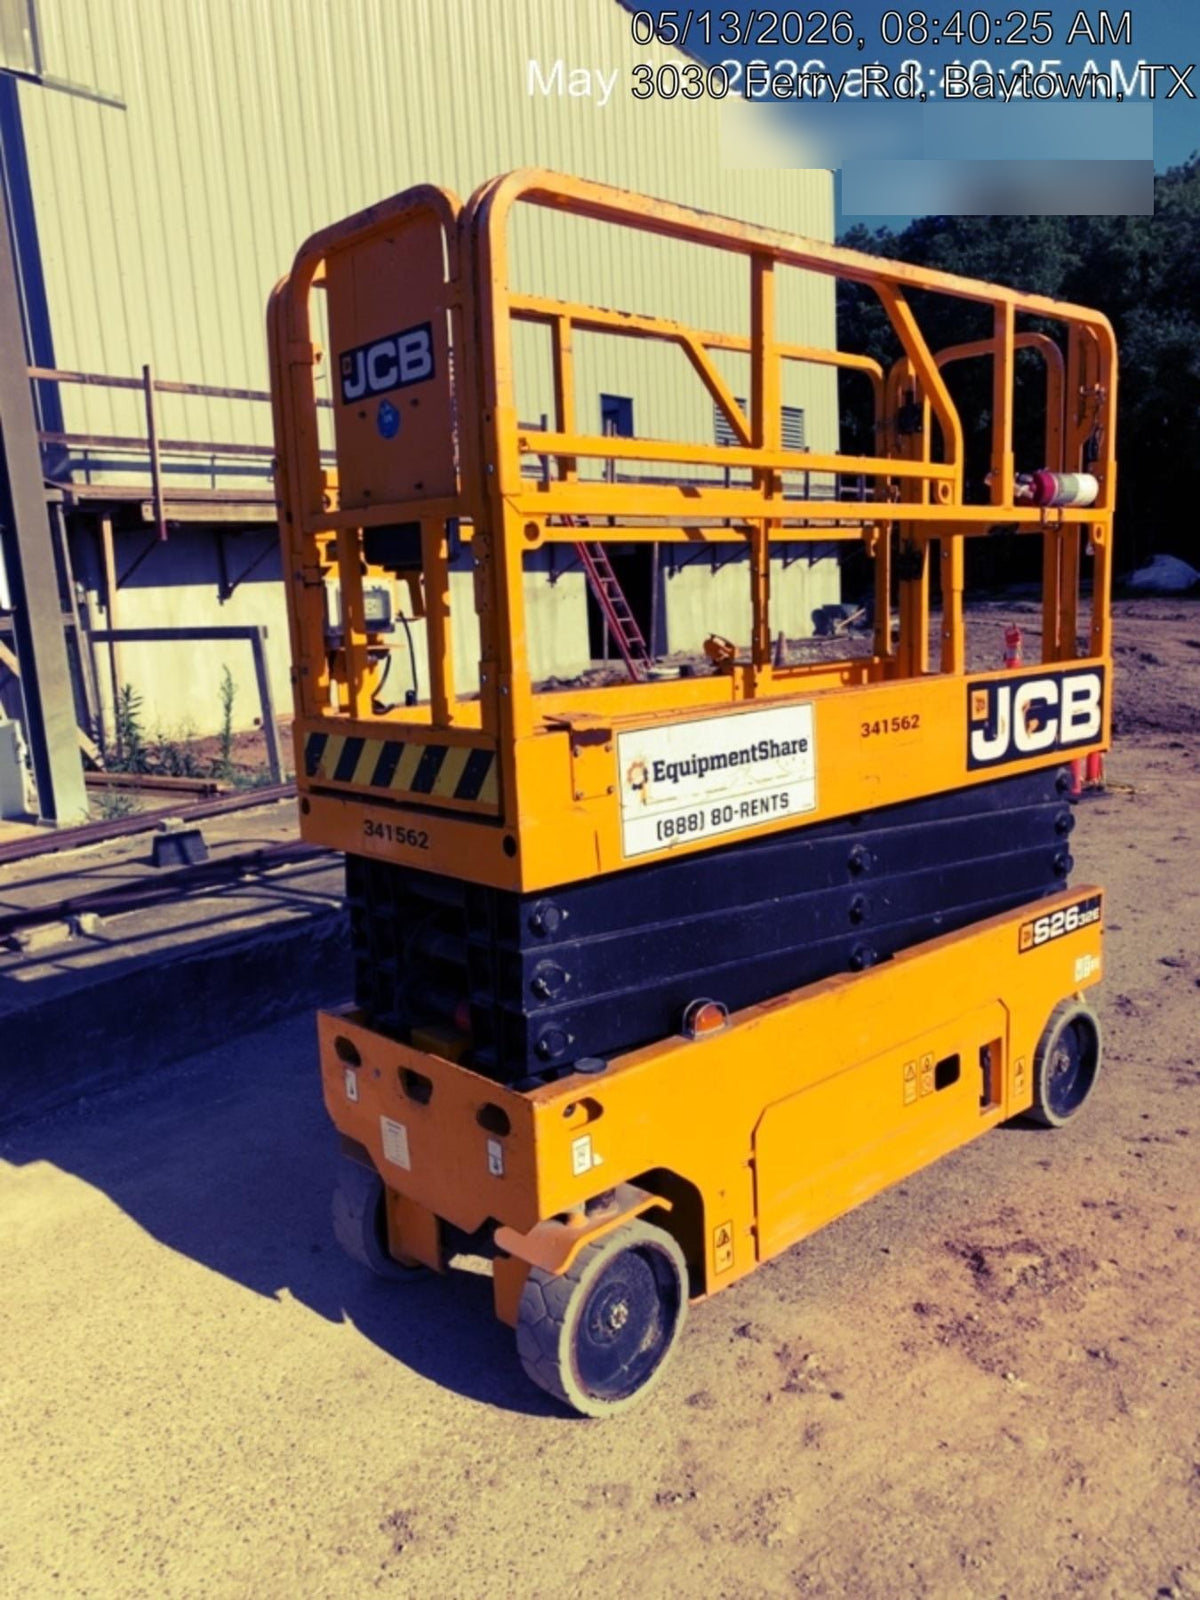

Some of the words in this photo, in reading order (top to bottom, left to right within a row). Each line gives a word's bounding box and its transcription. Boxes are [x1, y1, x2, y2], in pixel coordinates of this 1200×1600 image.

[344, 330, 432, 399] JCB
[861, 714, 920, 738] 341562
[971, 673, 1101, 761] JCB
[652, 738, 808, 784] EquipmentShare
[363, 819, 429, 849] 341562
[656, 811, 705, 841] (888)
[710, 793, 789, 826] 80-RENTS
